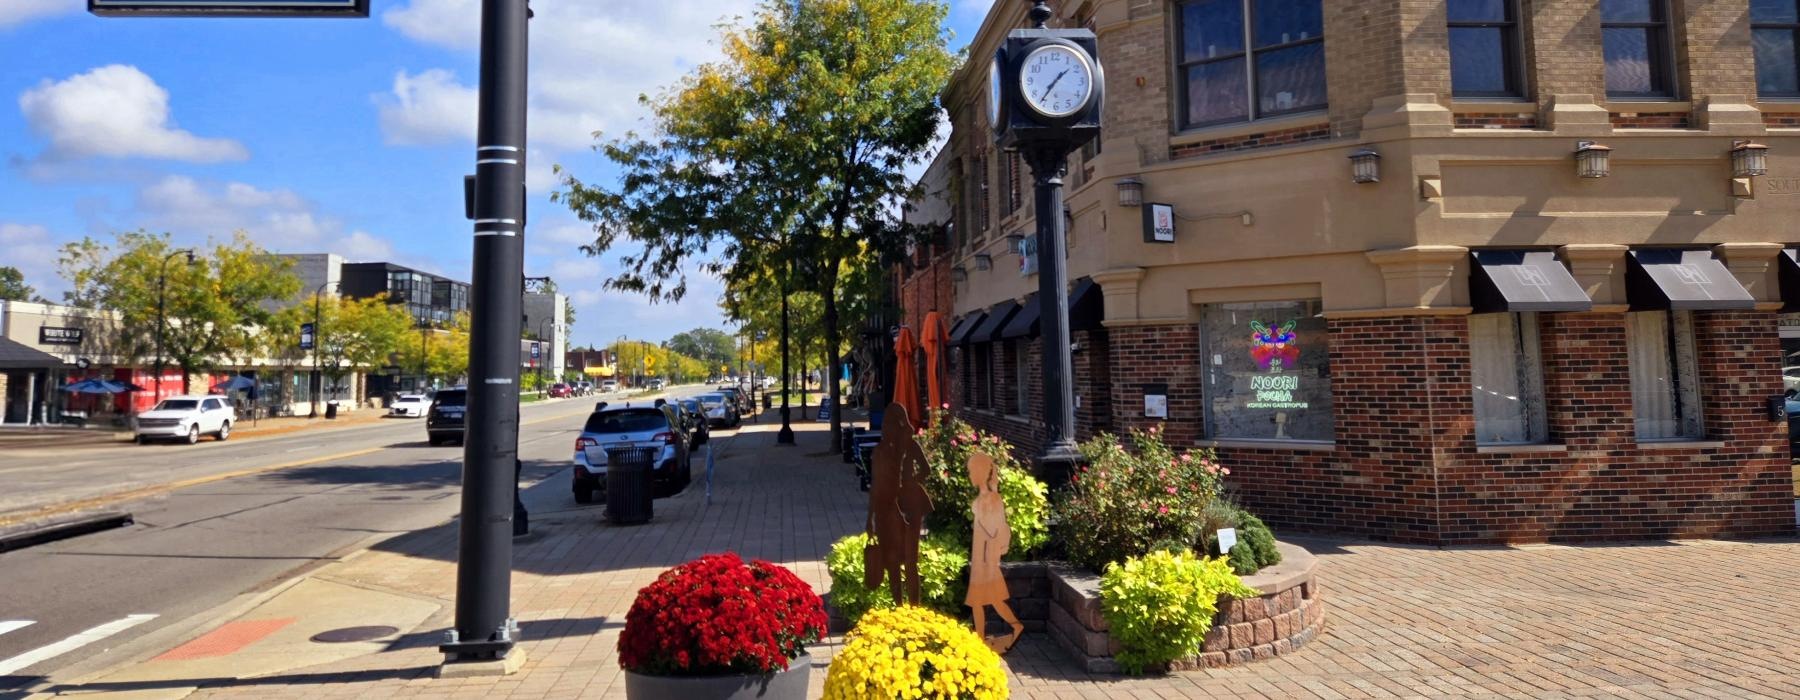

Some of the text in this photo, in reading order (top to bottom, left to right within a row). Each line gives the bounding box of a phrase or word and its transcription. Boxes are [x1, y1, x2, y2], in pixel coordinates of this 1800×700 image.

[1039, 56, 1048, 65] 11
[1051, 52, 1060, 60] 12
[1065, 56, 1070, 65] 1
[1032, 64, 1041, 73] 10
[1073, 64, 1079, 73] 2
[1027, 77, 1033, 86] 9
[1078, 77, 1084, 86] 3
[1031, 90, 1038, 99] 8
[1074, 90, 1080, 98] 4
[1053, 102, 1060, 110] 6
[1065, 99, 1071, 108] 5
[1155, 227, 1172, 236] NOORI
[1250, 375, 1298, 390] NOORI
[1256, 390, 1293, 402] POCHA
[1777, 405, 1785, 417] 5
